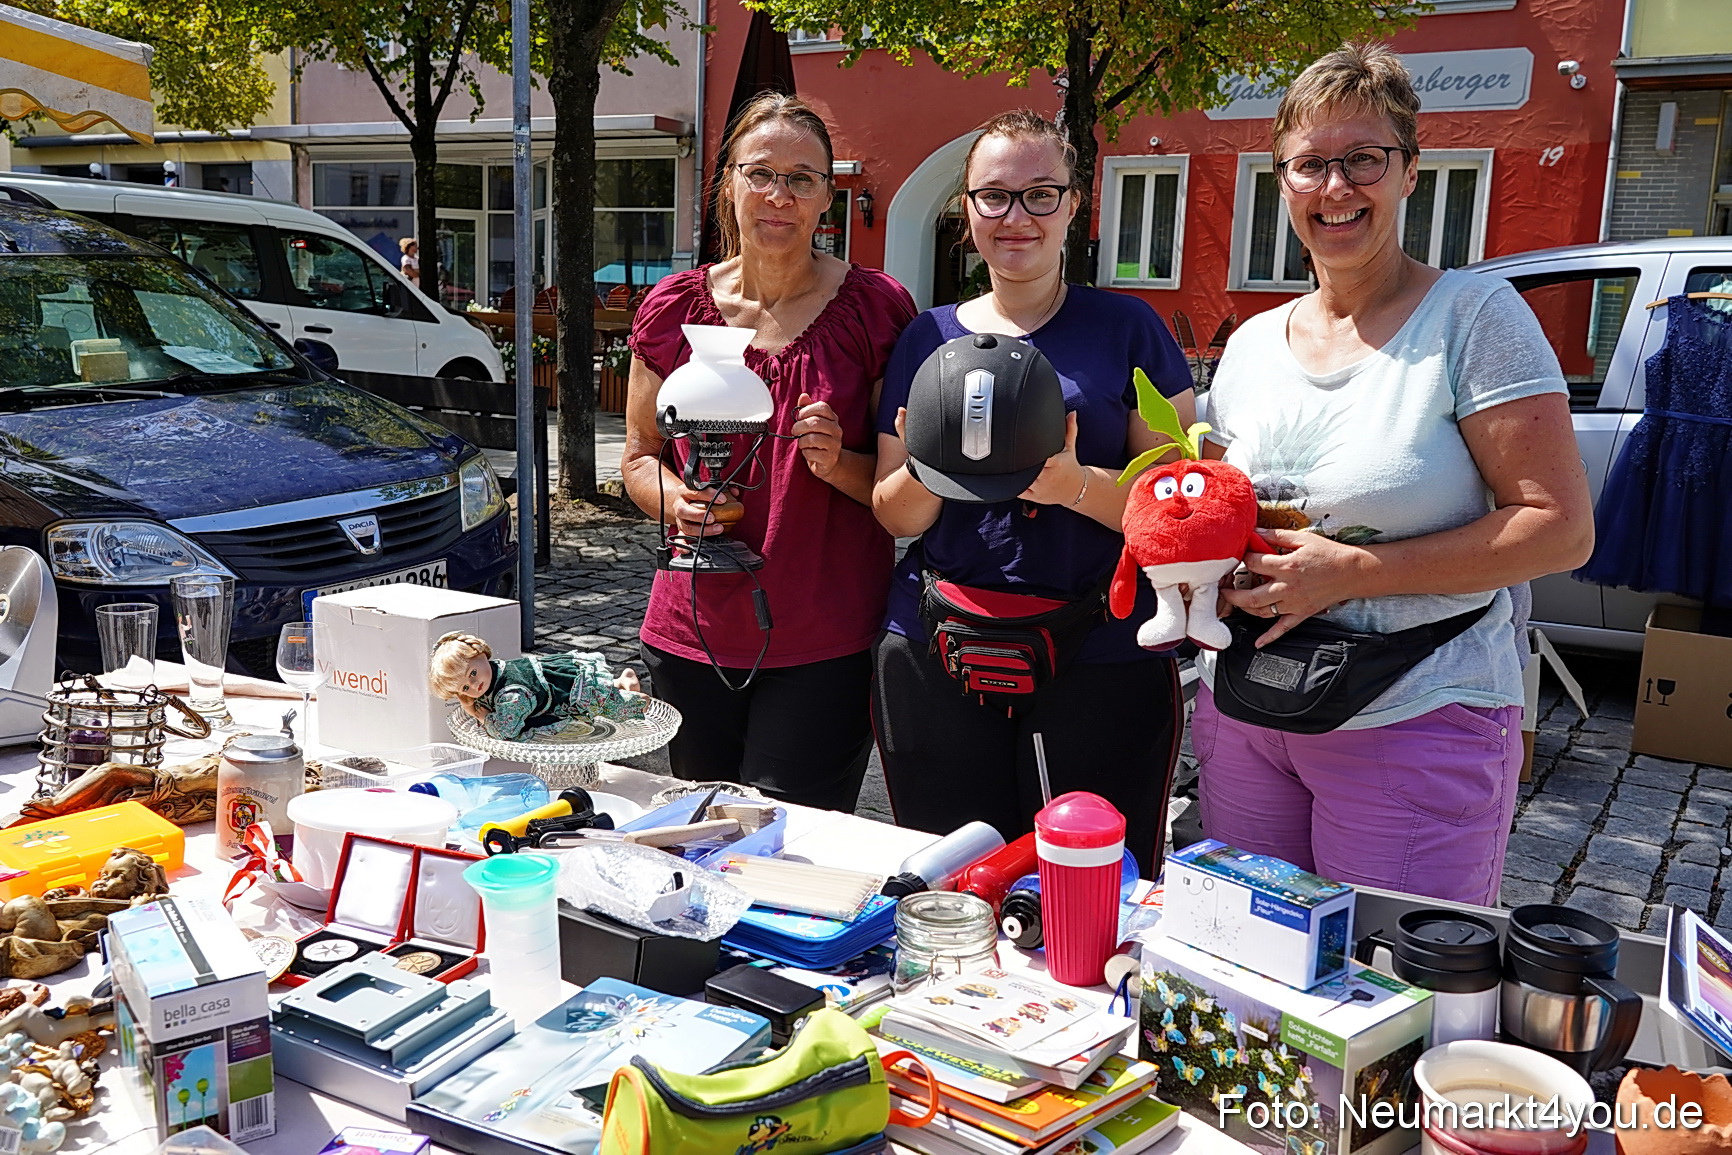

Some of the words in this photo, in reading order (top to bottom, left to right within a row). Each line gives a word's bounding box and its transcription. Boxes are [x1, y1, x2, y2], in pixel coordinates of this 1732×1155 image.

[1412, 66, 1510, 100] sberger
[1539, 146, 1564, 167] 19
[348, 520, 375, 530] DACIA
[163, 1003, 197, 1022] bella
[201, 997, 231, 1014] casa
[1287, 1020, 1335, 1047] Solar-Lichter-
[1287, 1030, 1306, 1044] kette
